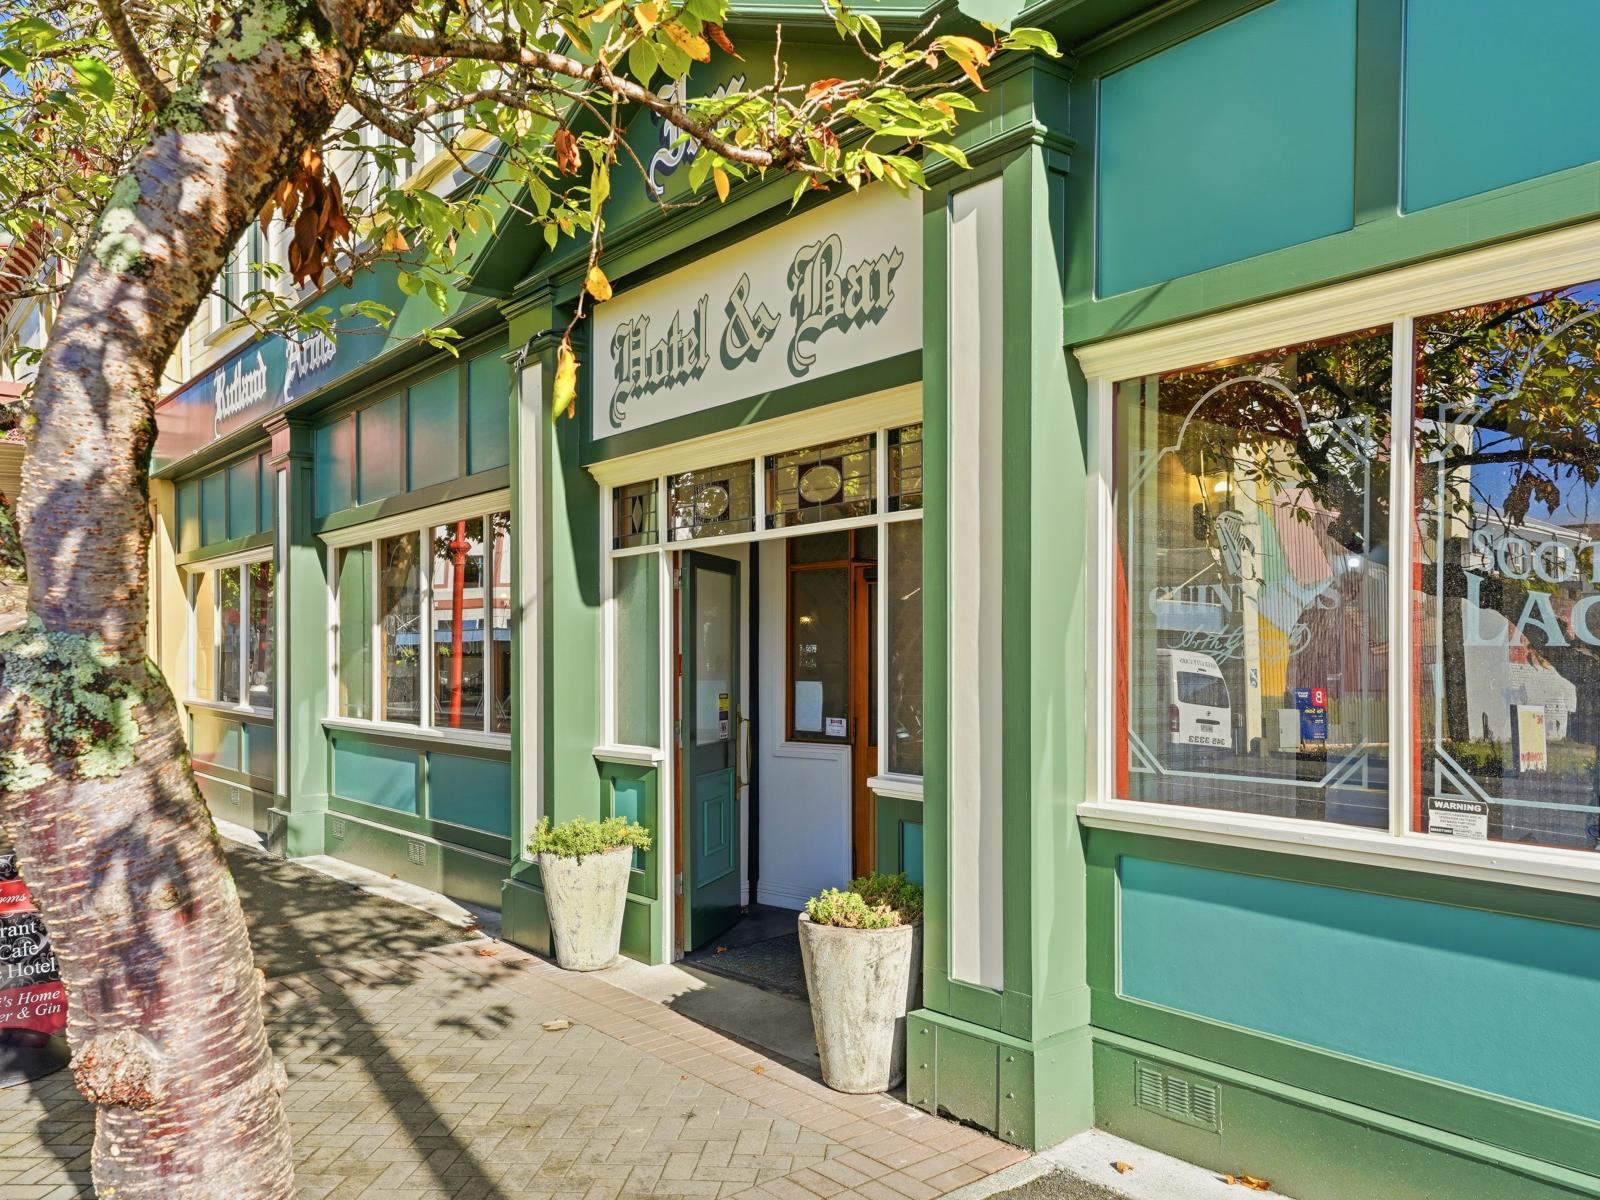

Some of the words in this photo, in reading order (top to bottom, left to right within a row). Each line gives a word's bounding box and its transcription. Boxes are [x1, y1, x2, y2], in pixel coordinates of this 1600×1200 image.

[609, 294, 711, 428] Hotel
[720, 272, 782, 370] &
[786, 233, 904, 378] Bar
[213, 350, 267, 441] Rutland
[1434, 800, 1482, 813] WARNING
[0, 940, 39, 960] Cafe
[7, 957, 57, 979] Hotel
[17, 989, 60, 1006] Home
[16, 1006, 31, 1020] &
[35, 1002, 61, 1016] Gin
